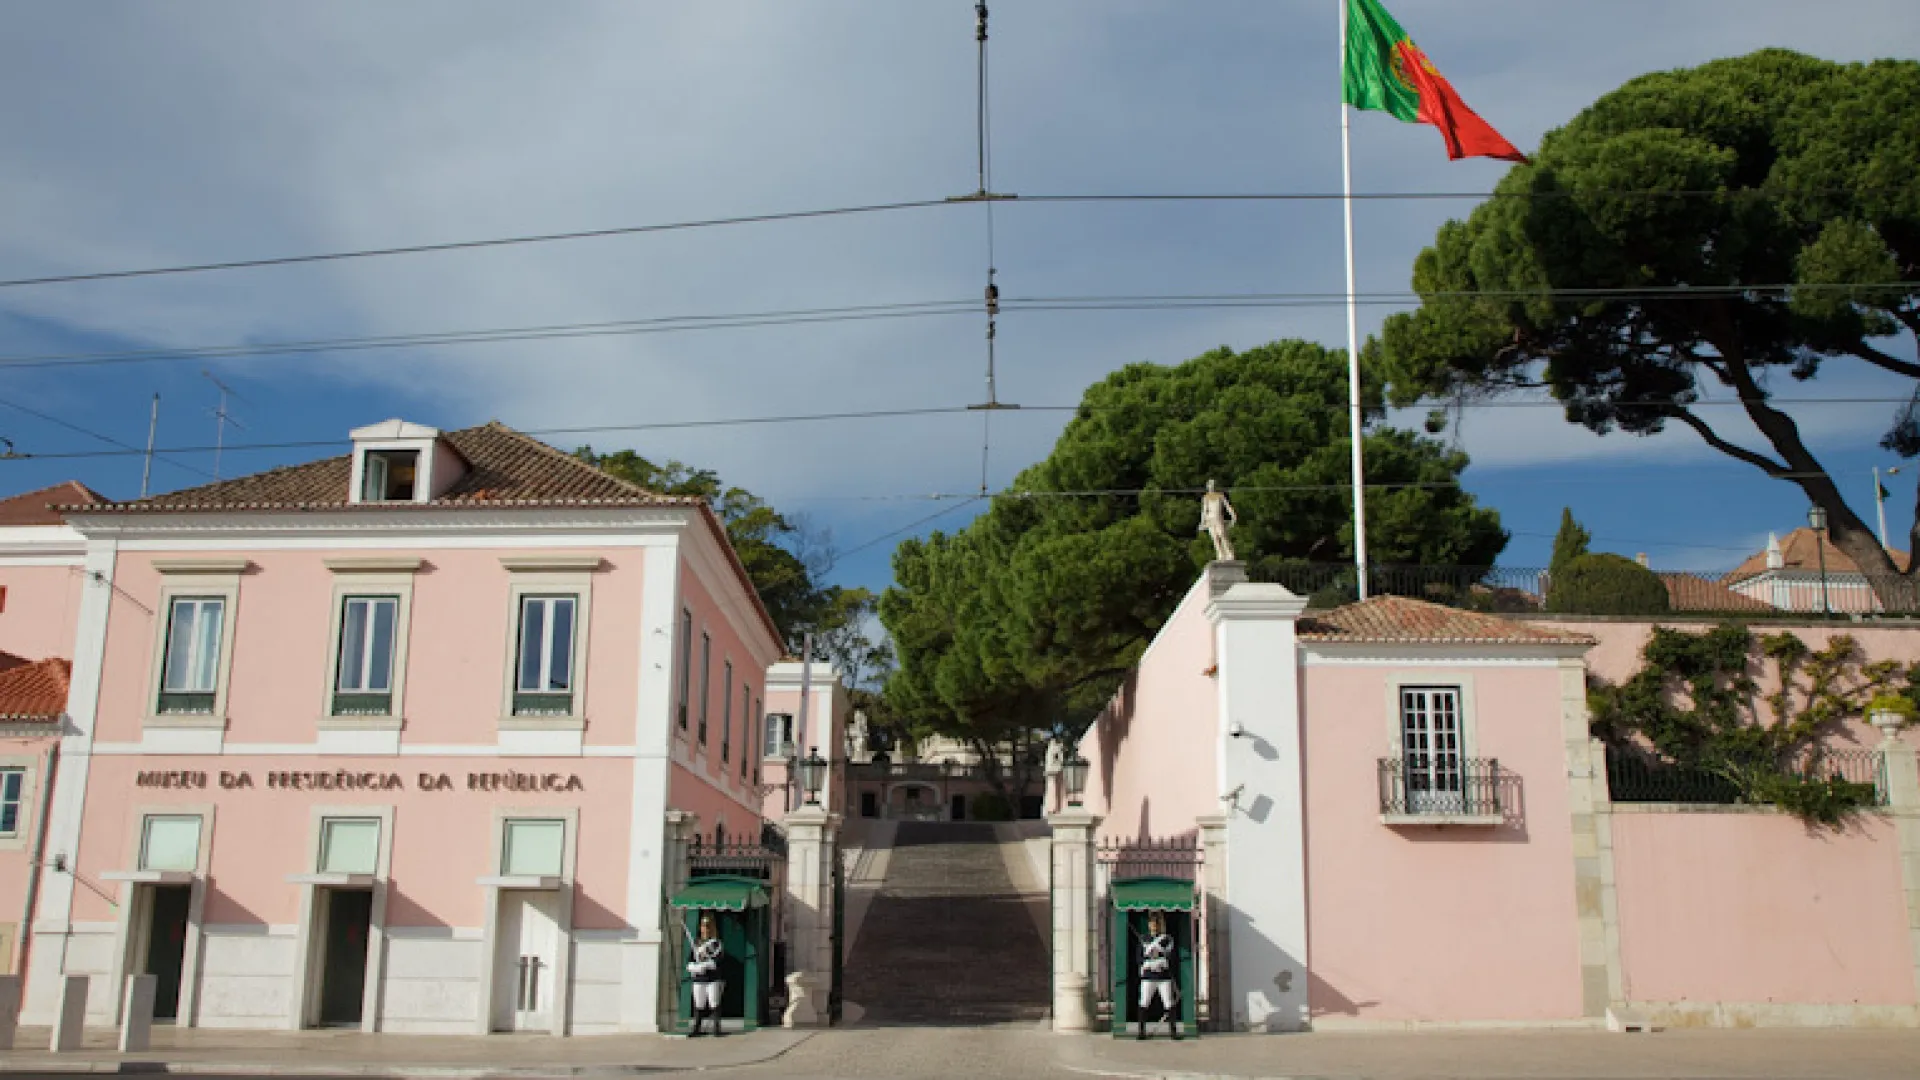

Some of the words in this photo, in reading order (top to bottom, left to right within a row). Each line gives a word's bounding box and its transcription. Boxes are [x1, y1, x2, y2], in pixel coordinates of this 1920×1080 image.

[137, 770, 207, 789] MUSEU
[218, 770, 254, 789] DA
[267, 768, 404, 791] PRESIDÊNCIA
[417, 772, 454, 792] DA
[466, 768, 584, 792] REPÚBLICA
